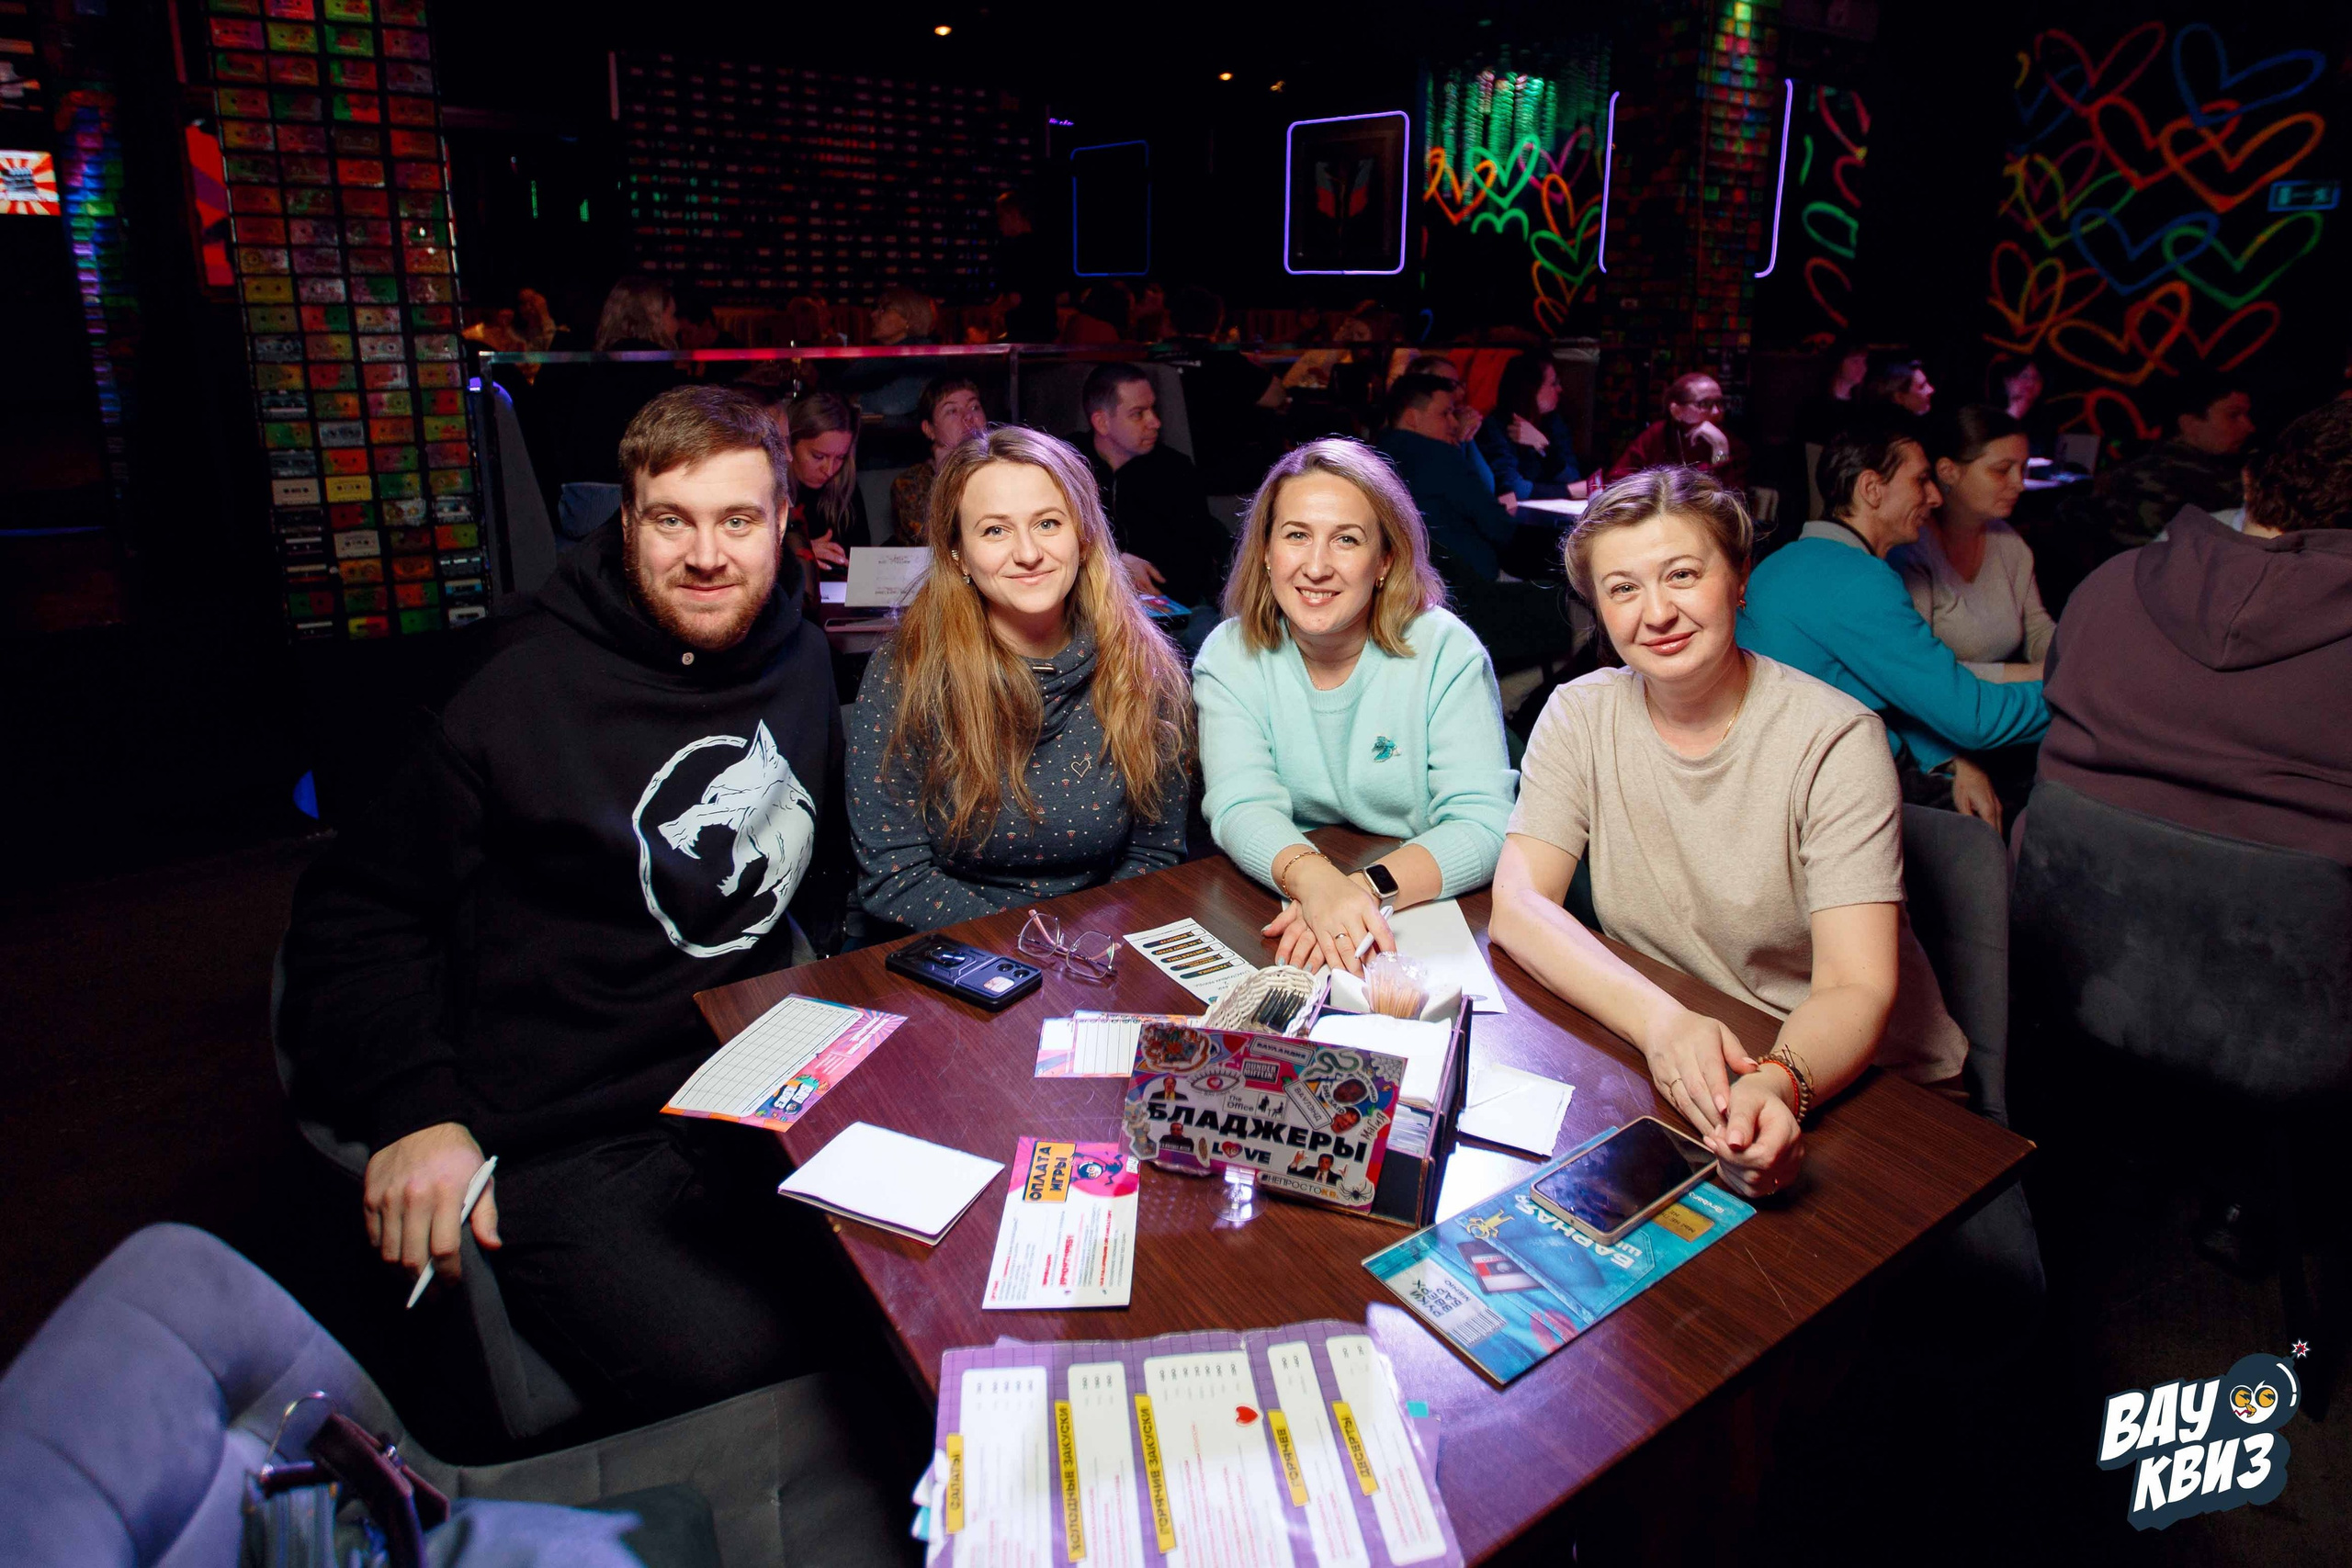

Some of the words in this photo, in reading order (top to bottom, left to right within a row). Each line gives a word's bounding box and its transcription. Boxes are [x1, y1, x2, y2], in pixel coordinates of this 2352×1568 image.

[1148, 1102, 1367, 1163] БЛАДЖЕРЫ
[1227, 1102, 1254, 1112] Office
[1294, 1088, 1322, 1122] ВАУЛЭНД
[1029, 1145, 1052, 1201] ОПЛАТА
[1049, 1156, 1068, 1191] ИГРЫ
[1409, 1290, 1443, 1318] РУКИ
[1412, 1279, 1453, 1314] ВВЕРХ
[1436, 1288, 1463, 1308] БАР
[1444, 1280, 1472, 1302] МЕНЮ
[1058, 1407, 1073, 1467] ЗАКУСКИ
[1140, 1407, 1158, 1467] ЗАКУСКИ
[1276, 1428, 1300, 1487] ГОРЯЧЕЕ
[1342, 1416, 1370, 1477] ДЕСЕРТЫ
[949, 1453, 961, 1510] САЛАТЫ
[1150, 1471, 1170, 1535] ГОРЯЧИЕ
[1064, 1472, 1081, 1552] ХОЛОДНЫЕ
